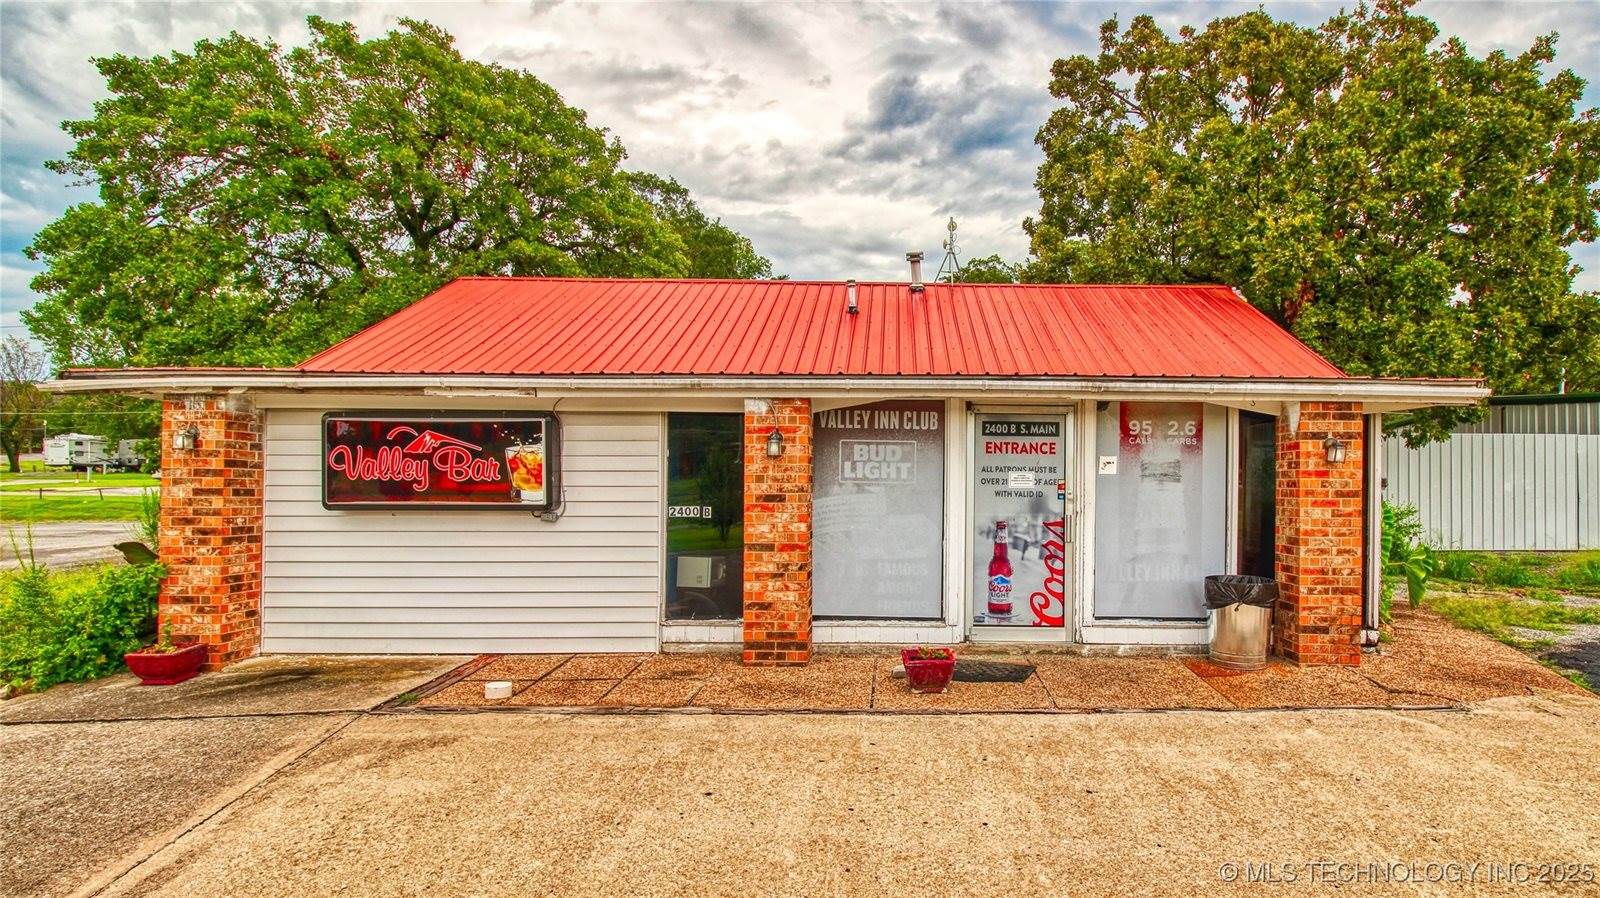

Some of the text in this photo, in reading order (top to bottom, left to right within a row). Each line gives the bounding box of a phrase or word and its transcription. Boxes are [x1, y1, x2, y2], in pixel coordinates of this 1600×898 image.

[819, 410, 939, 430] VALLEY INN CLUB
[985, 423, 1056, 435] 2400 B S. MAIN
[1128, 420, 1196, 436] 95 2.6
[985, 441, 1057, 455] ENTRANCE
[1166, 437, 1197, 446] CARBS
[853, 444, 903, 461] BUD
[329, 445, 501, 492] Valley Bar
[843, 461, 913, 479] LIGHT
[981, 465, 1057, 474] ALL PATRONS MUST BE
[980, 478, 1001, 486] OVER
[1043, 478, 1058, 486] AGE
[994, 490, 1044, 498] WITH VALID ID
[669, 506, 712, 518] 2400 B
